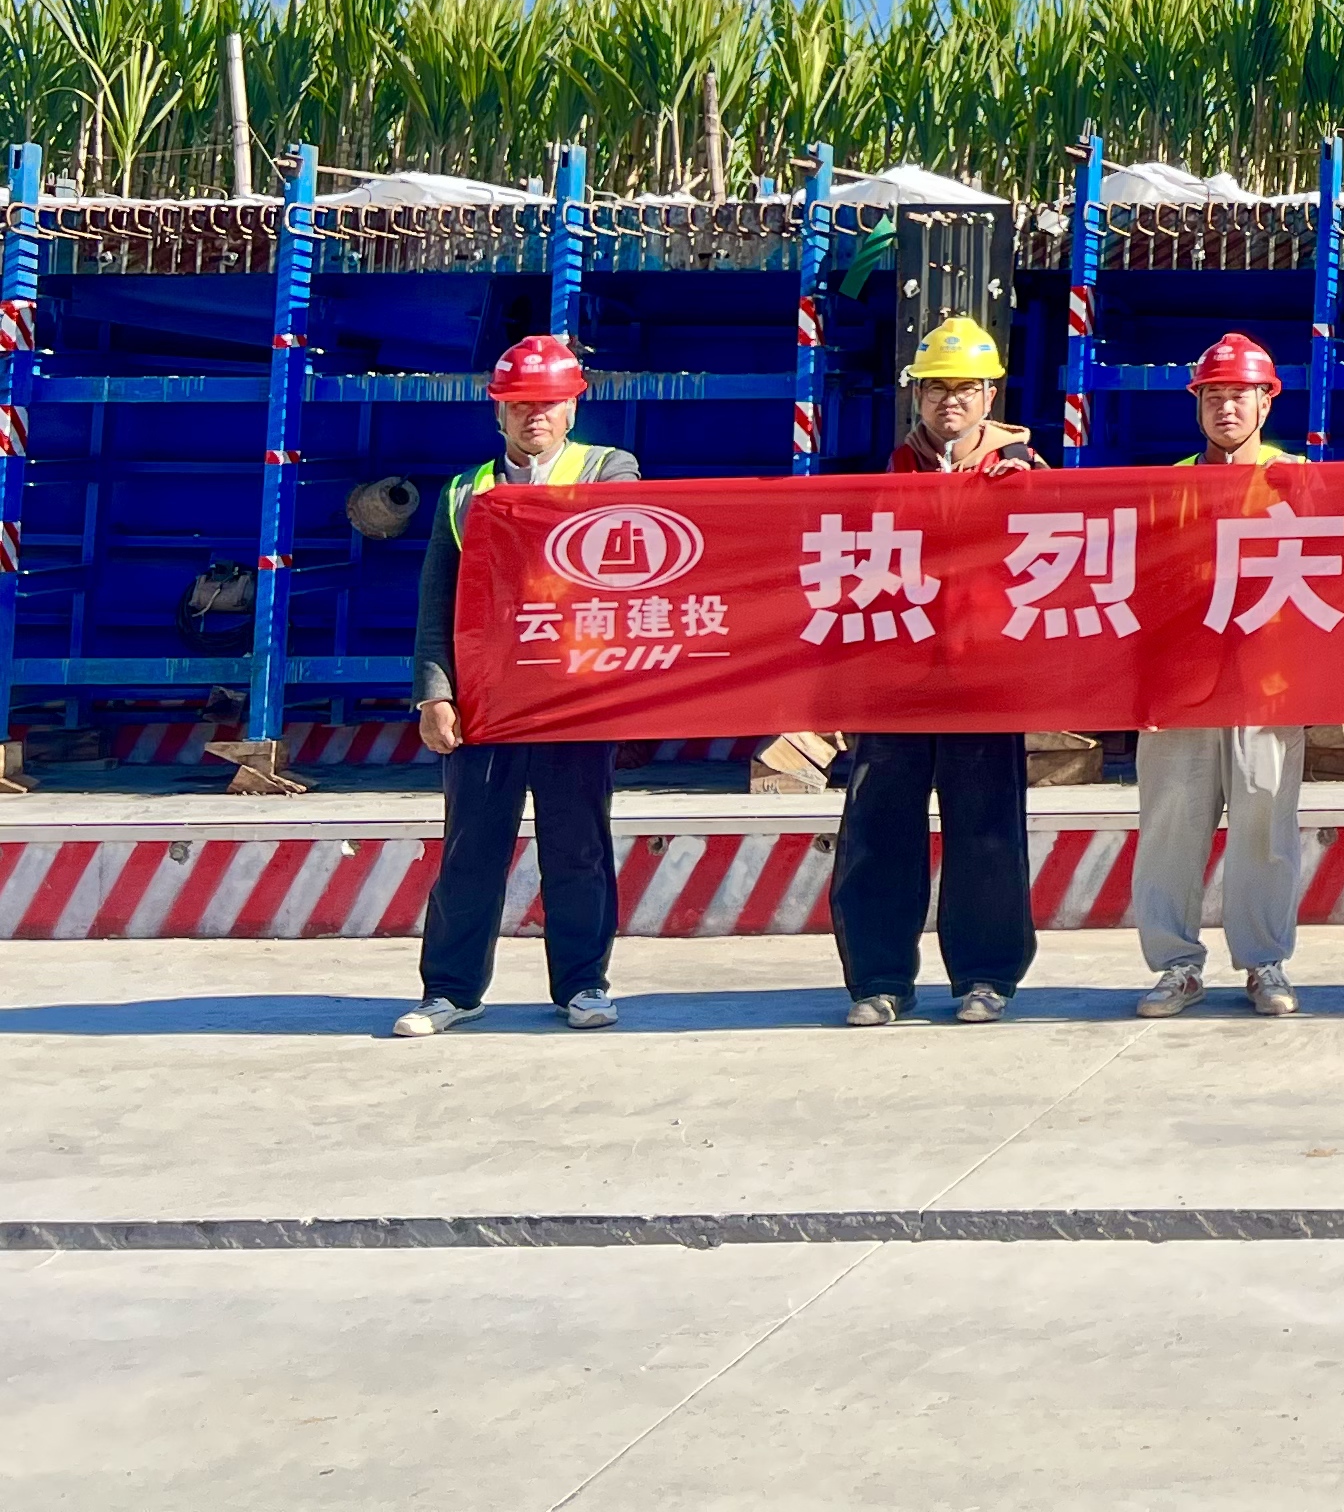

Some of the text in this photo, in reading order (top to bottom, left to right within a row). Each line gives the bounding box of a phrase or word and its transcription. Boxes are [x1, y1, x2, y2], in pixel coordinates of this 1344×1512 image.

[516, 594, 729, 642] 云南建投
[566, 644, 683, 674] YCIH
